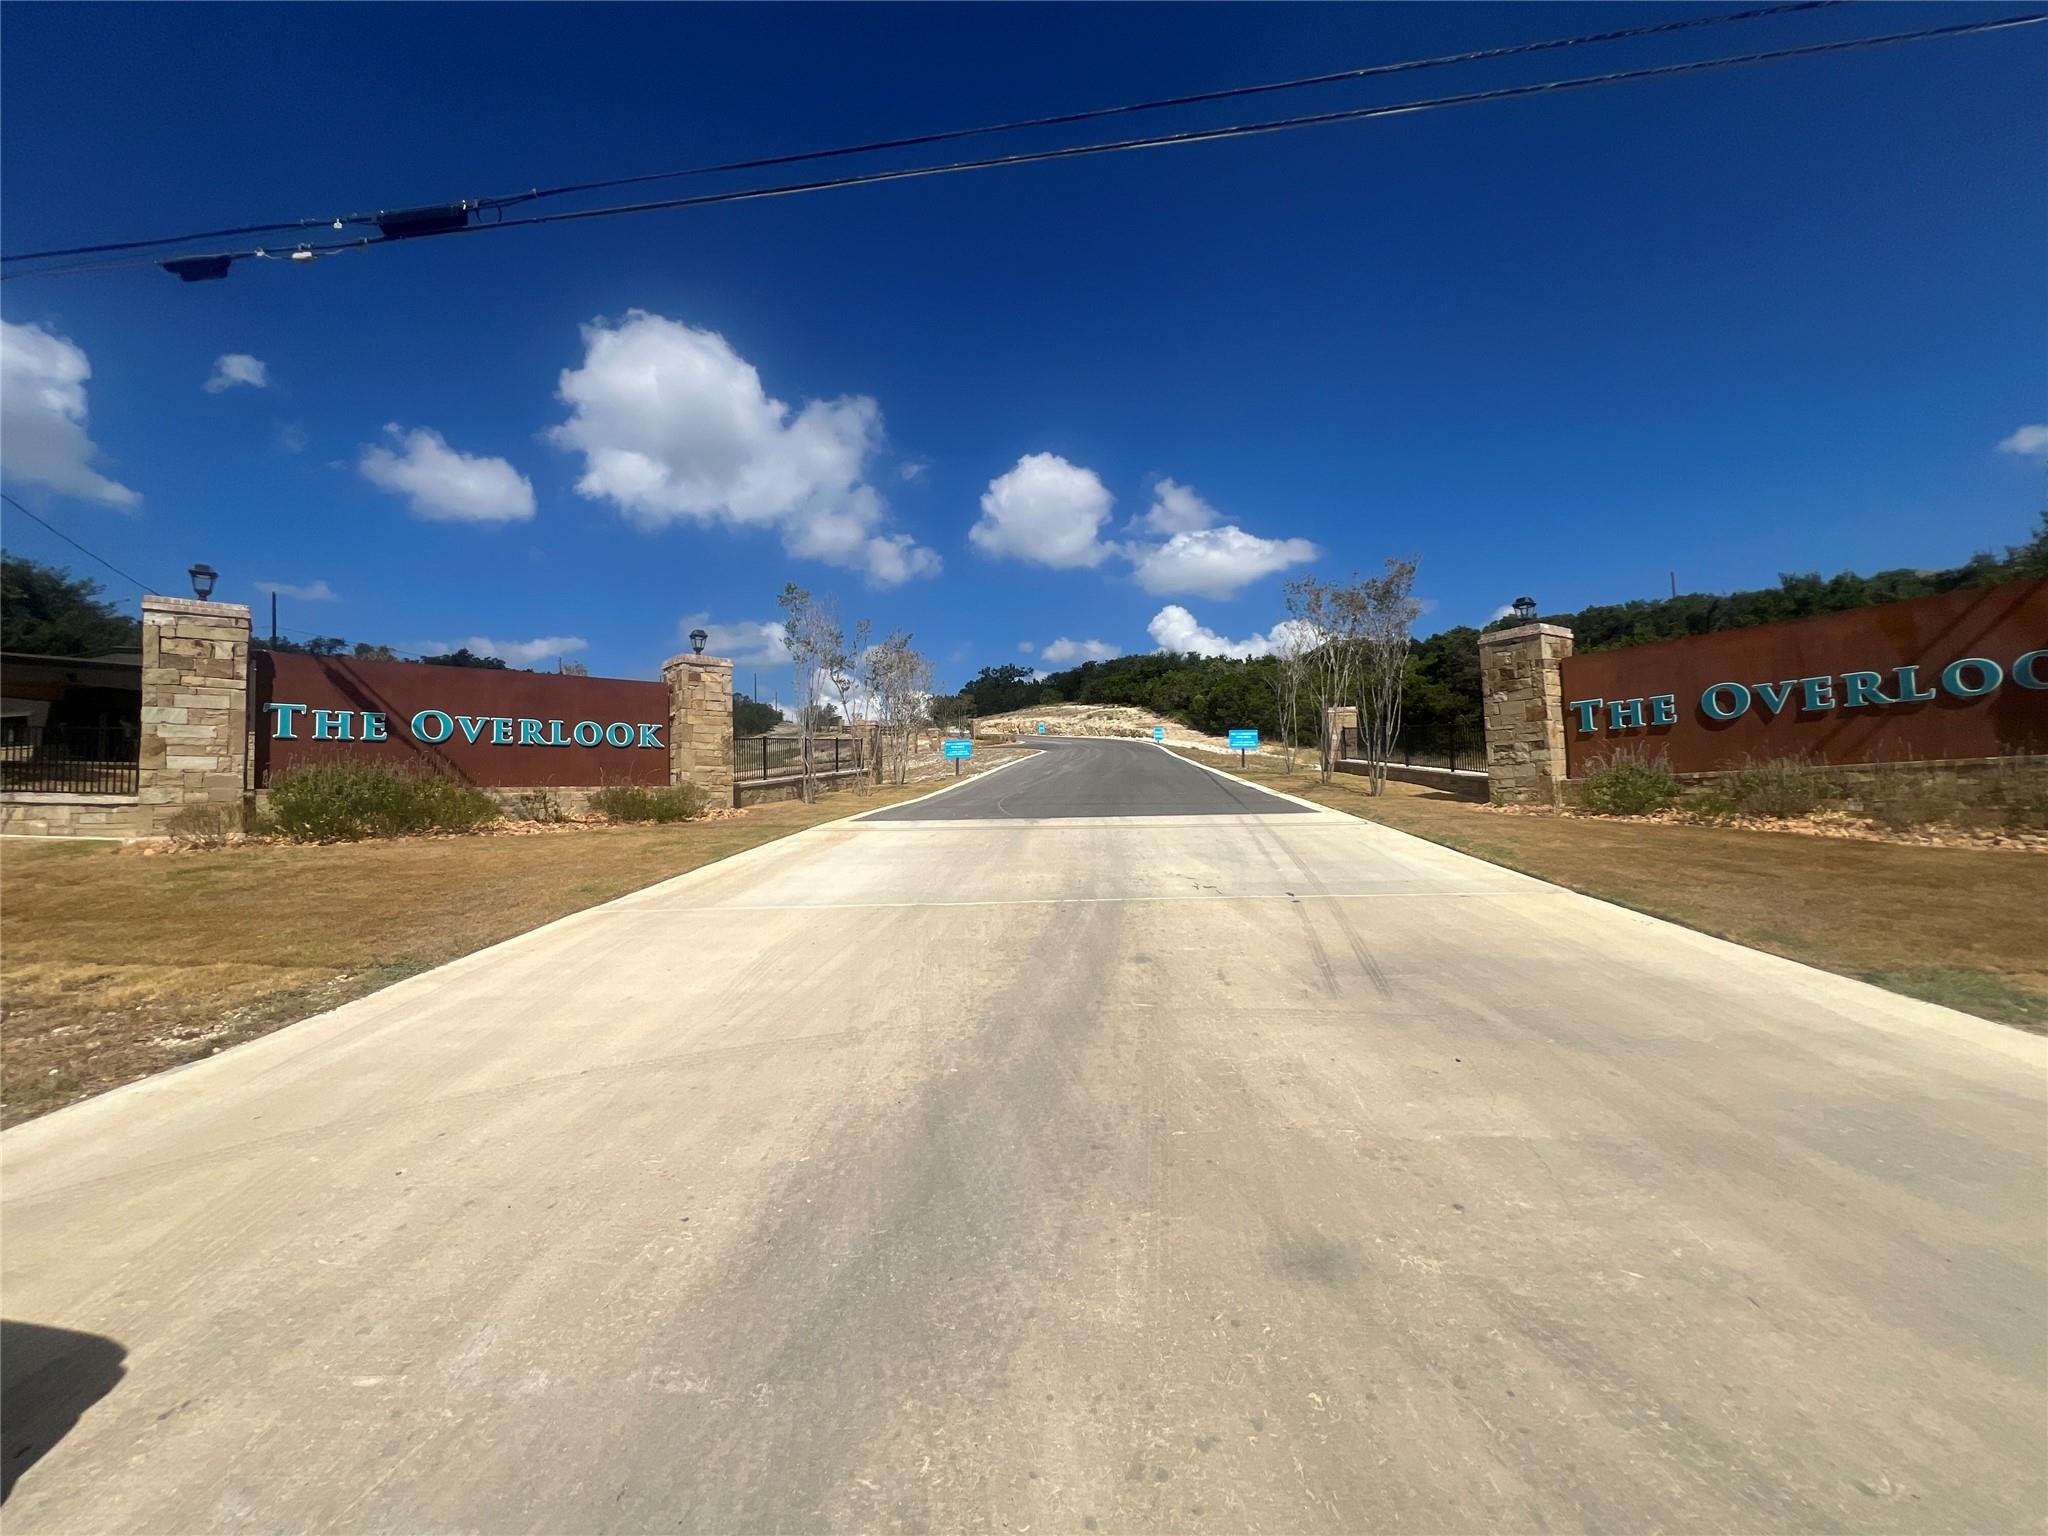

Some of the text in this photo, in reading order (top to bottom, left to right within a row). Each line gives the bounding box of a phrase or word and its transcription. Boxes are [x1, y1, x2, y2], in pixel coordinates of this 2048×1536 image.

[263, 702, 665, 748] THE OVERLOOK
[1569, 694, 1678, 733] THE
